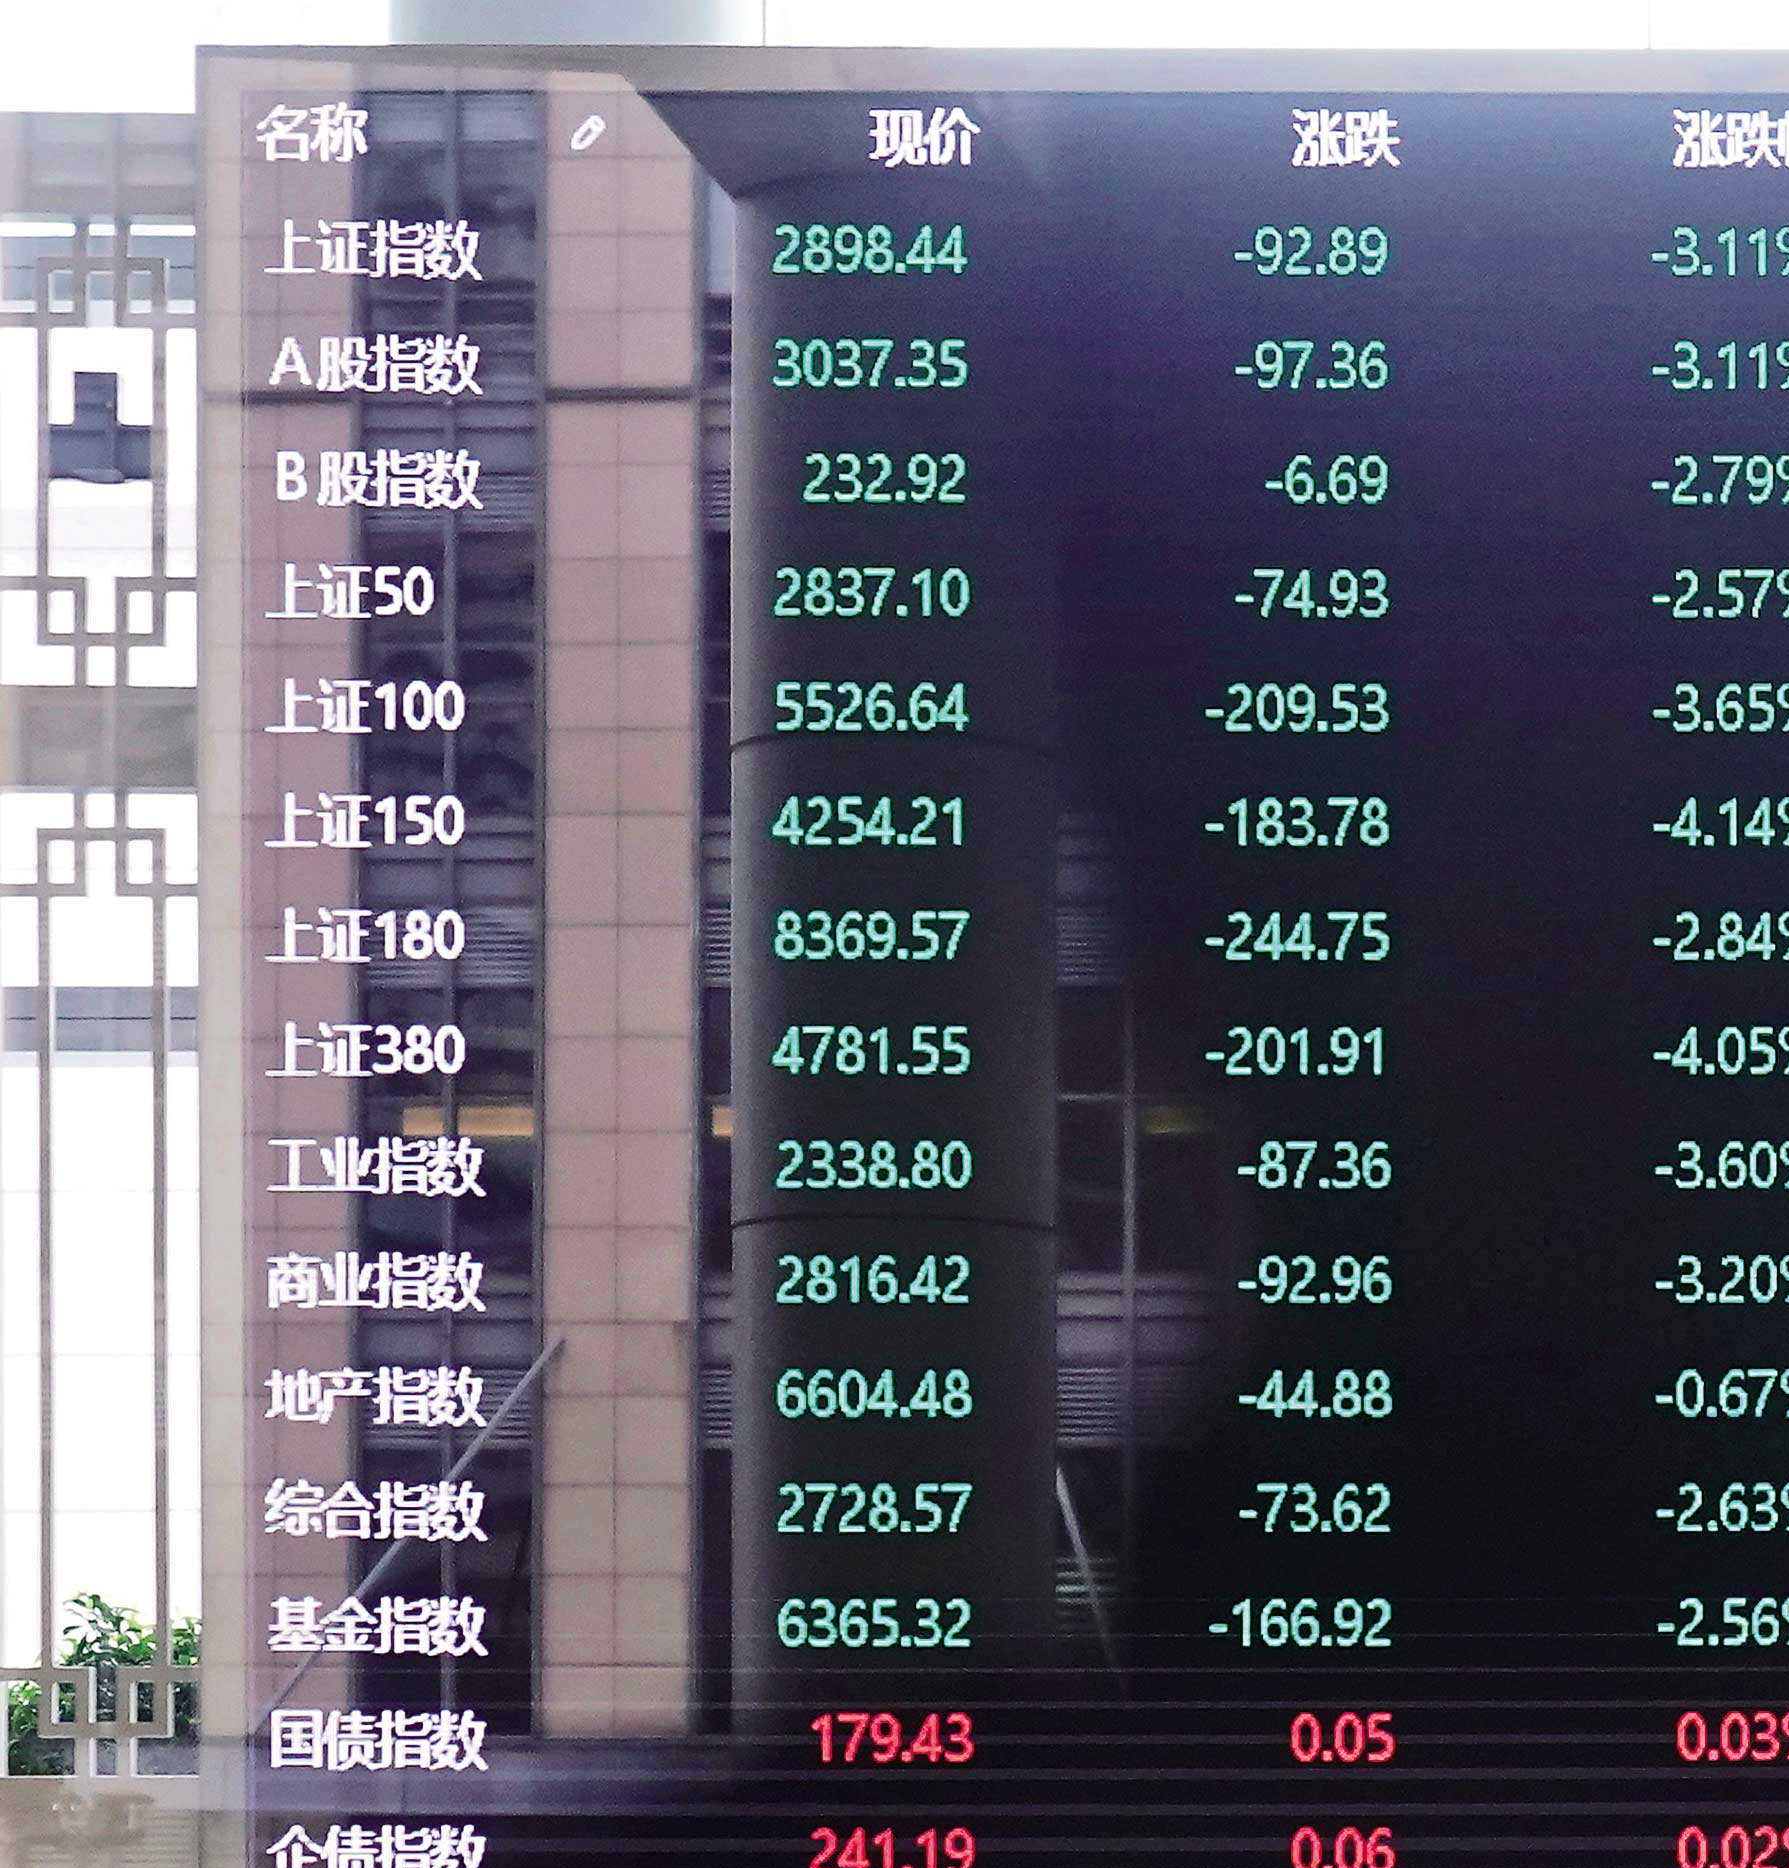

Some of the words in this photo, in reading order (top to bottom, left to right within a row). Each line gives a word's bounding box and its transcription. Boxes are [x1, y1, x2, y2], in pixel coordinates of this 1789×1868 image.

[257, 102, 368, 162] 名称
[869, 107, 980, 167] 现价
[1292, 109, 1400, 167] 涨跌
[264, 219, 483, 280] 上证指数
[773, 225, 967, 273] 2898.44
[1235, 226, 1387, 275] -92.89
[803, 453, 965, 503] 232.92
[1265, 455, 1388, 504] -6.69
[265, 679, 465, 733] 上证100
[776, 682, 969, 731] 5526.64
[1206, 683, 1389, 732] -209.53
[266, 907, 465, 962] 上证180
[775, 911, 970, 960] 8369.57
[1205, 912, 1389, 960] -244.75
[268, 1138, 487, 1198] 工业指数
[776, 1140, 972, 1188] 2338.80
[1238, 1141, 1391, 1189] -87.36
[264, 1366, 488, 1428] 地产指数
[777, 1369, 972, 1418] 6604.48
[1239, 1369, 1392, 1417] -44.88
[268, 1594, 488, 1656] 基金指数
[778, 1598, 970, 1647] 6365.32
[1209, 1598, 1391, 1646] -166.92
